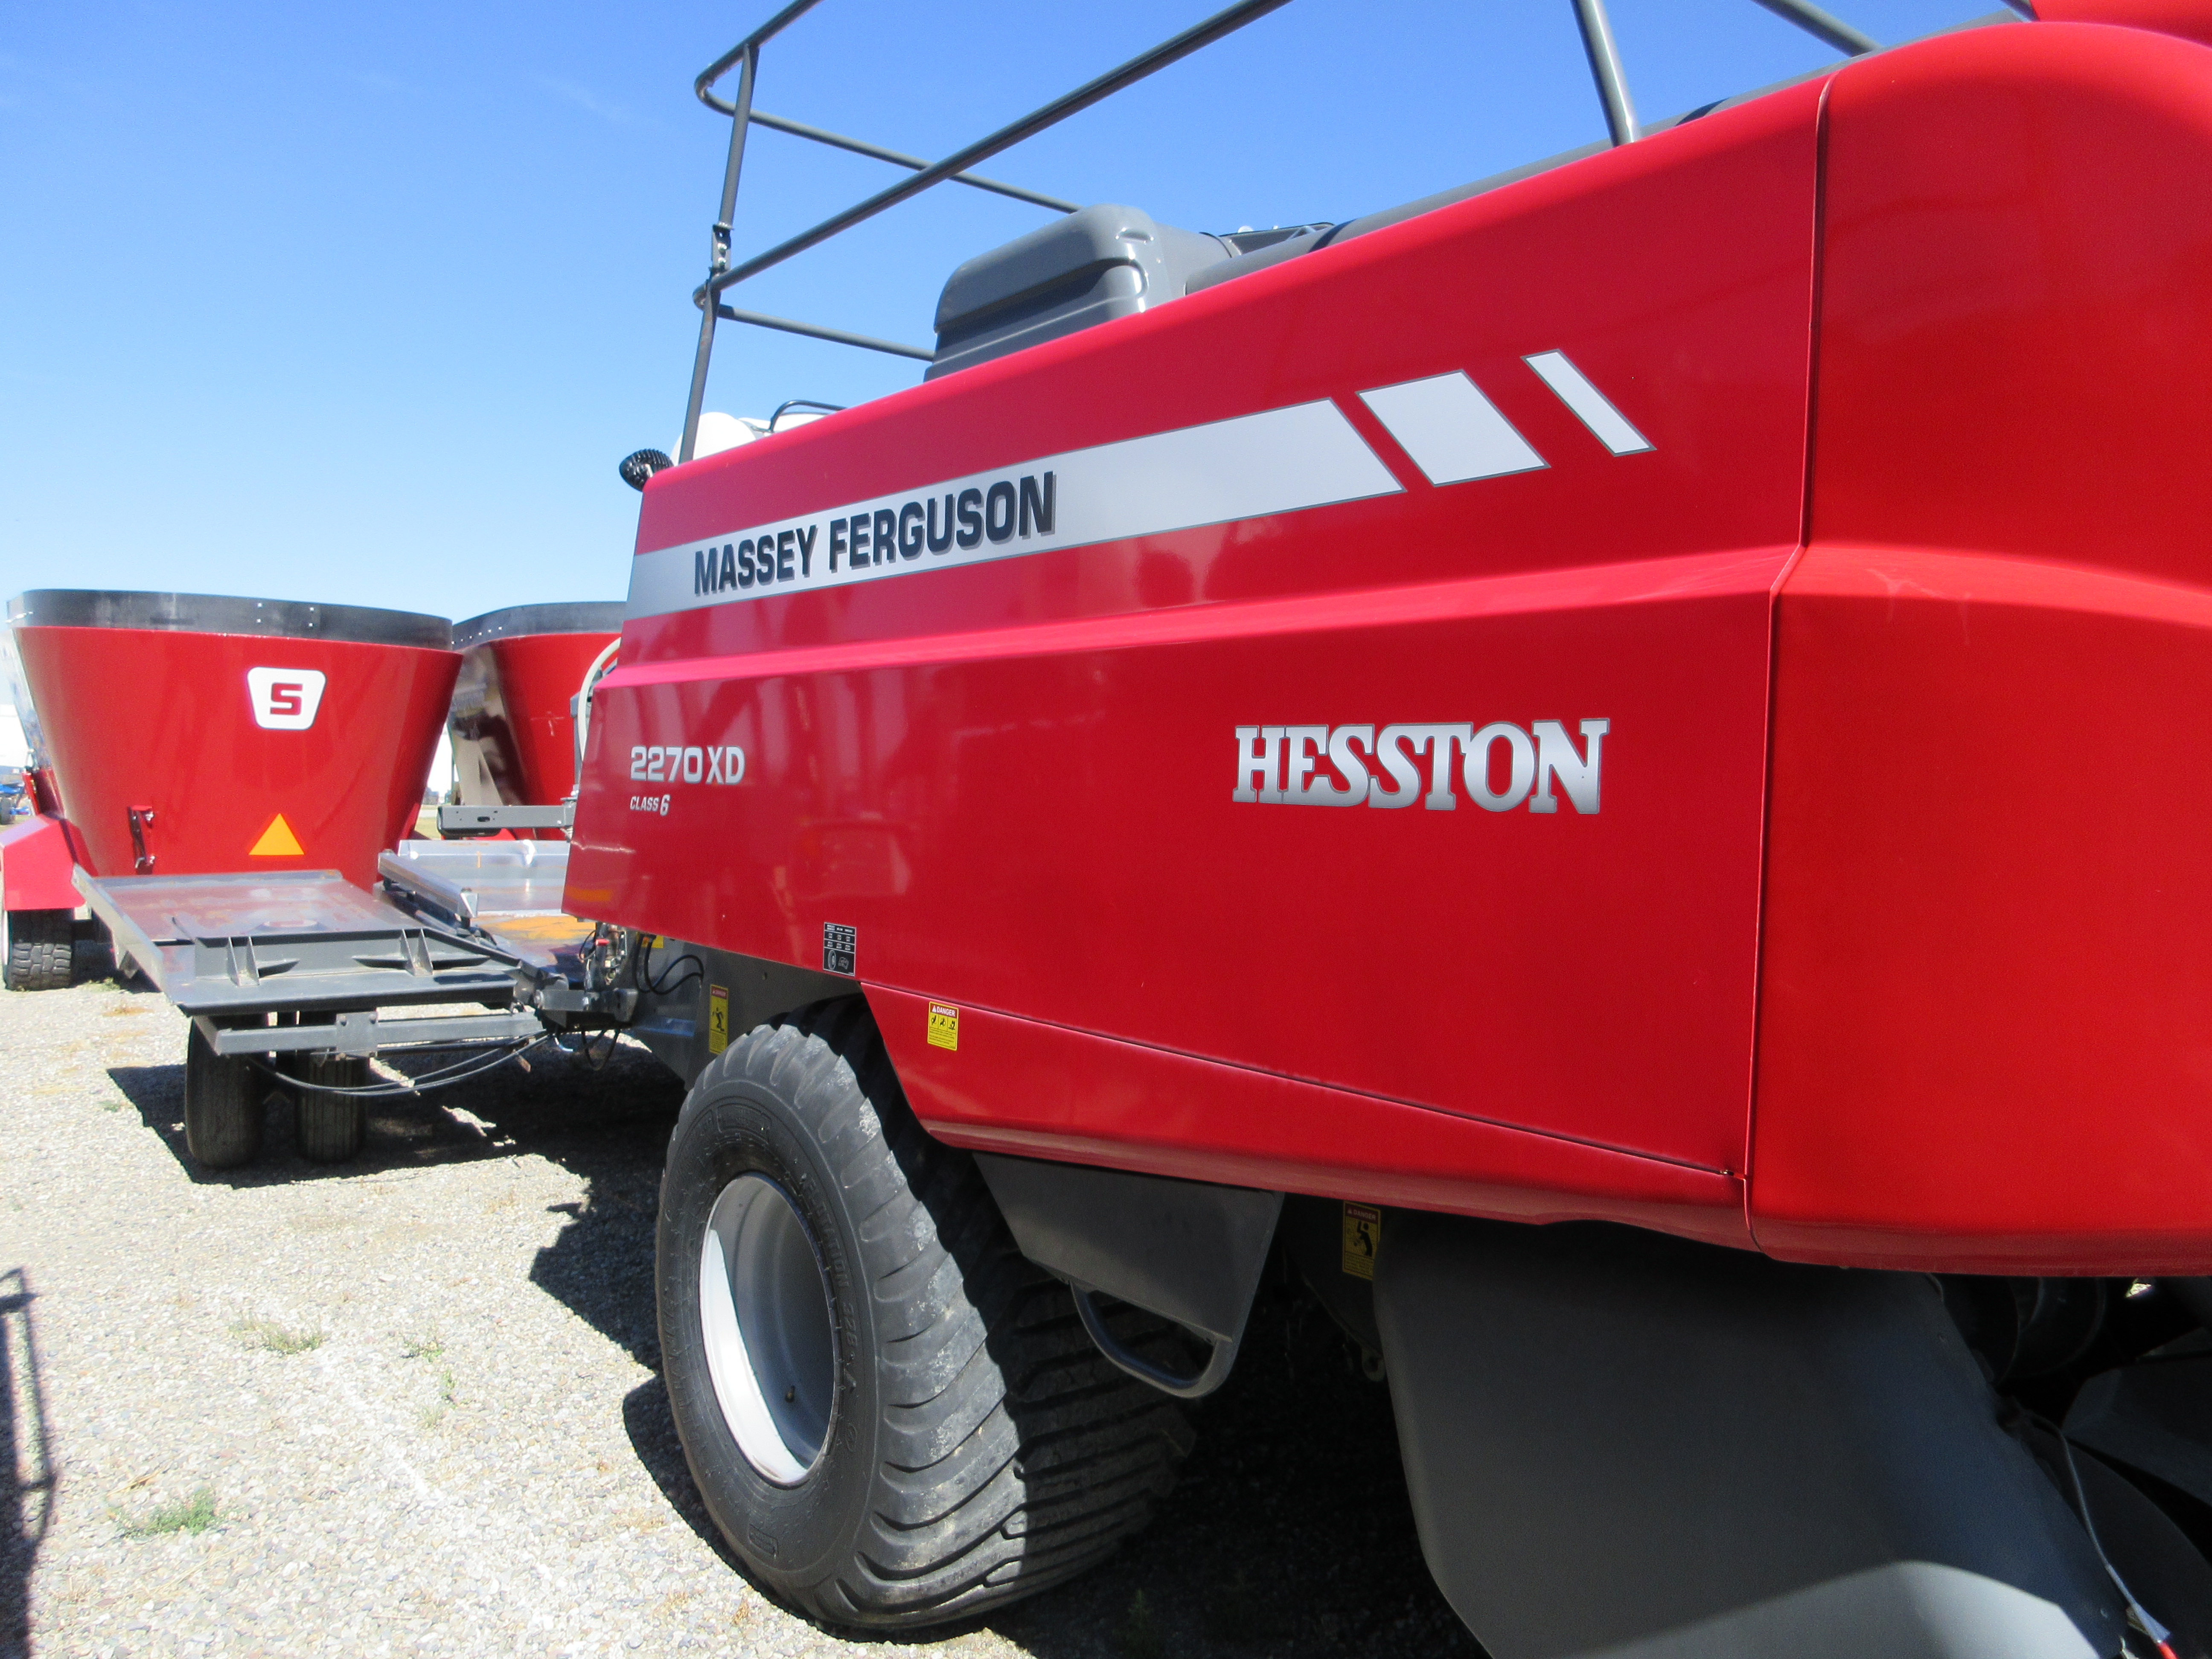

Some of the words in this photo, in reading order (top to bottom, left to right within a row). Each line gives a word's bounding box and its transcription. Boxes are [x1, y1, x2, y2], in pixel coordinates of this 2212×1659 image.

[694, 525, 818, 596] MASSEY
[829, 471, 1057, 570] FERGUSON
[270, 682, 303, 715] S
[1232, 717, 1610, 814] HESSTON
[630, 795, 659, 812] CLASS
[660, 794, 671, 816] 6
[937, 1006, 955, 1017] DANGER
[1353, 1209, 1377, 1220] DANGER
